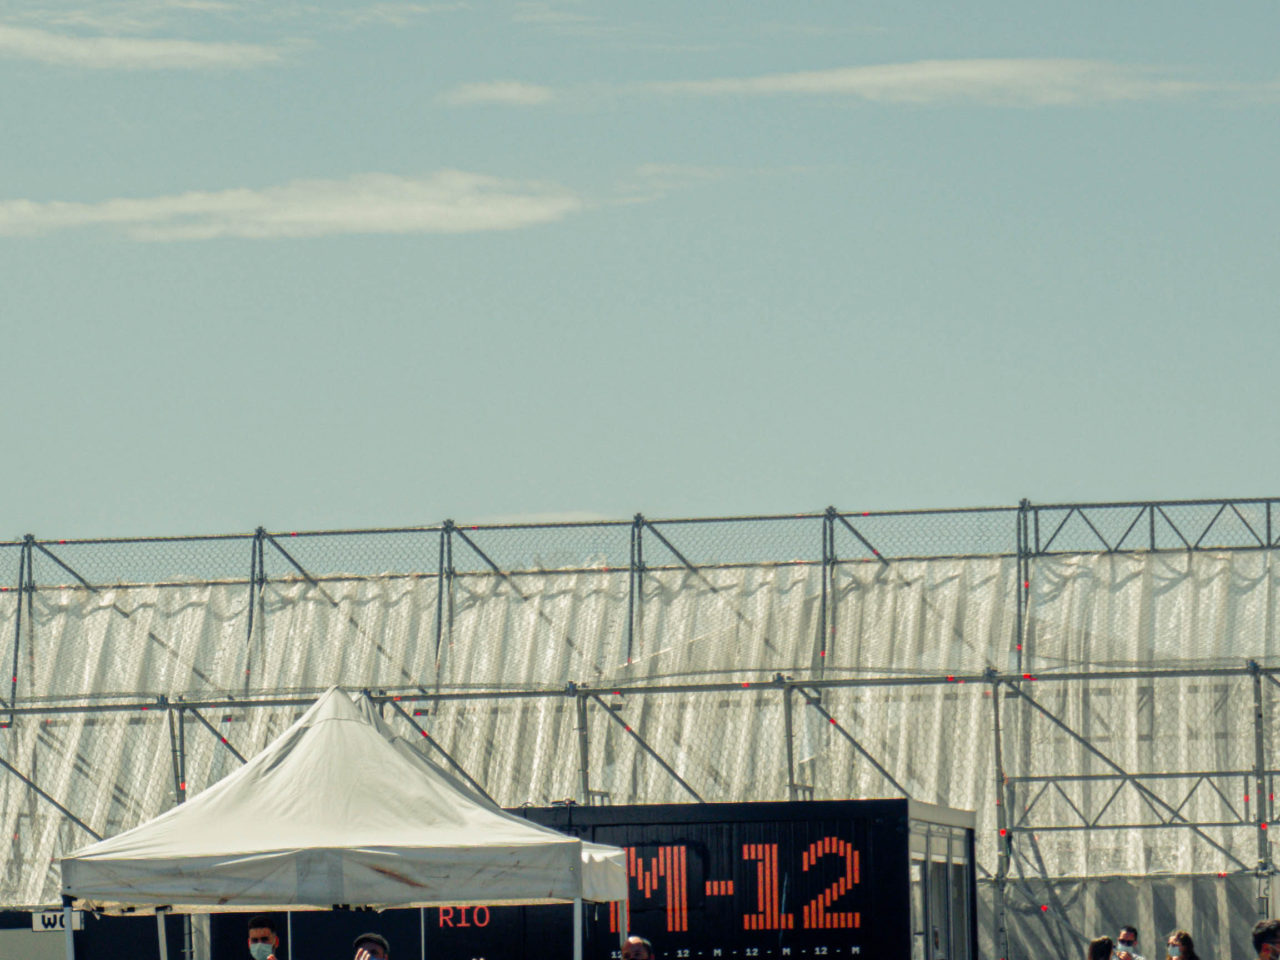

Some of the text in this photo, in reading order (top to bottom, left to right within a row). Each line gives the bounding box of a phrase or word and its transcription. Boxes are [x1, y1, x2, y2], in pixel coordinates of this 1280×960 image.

[609, 836, 861, 933] M-12
[439, 906, 490, 928] RIO
[677, 949, 690, 958] 12
[713, 948, 722, 957] M
[745, 947, 759, 956] 12
[782, 947, 791, 956] M
[814, 947, 828, 955] 12
[852, 946, 860, 954] M
